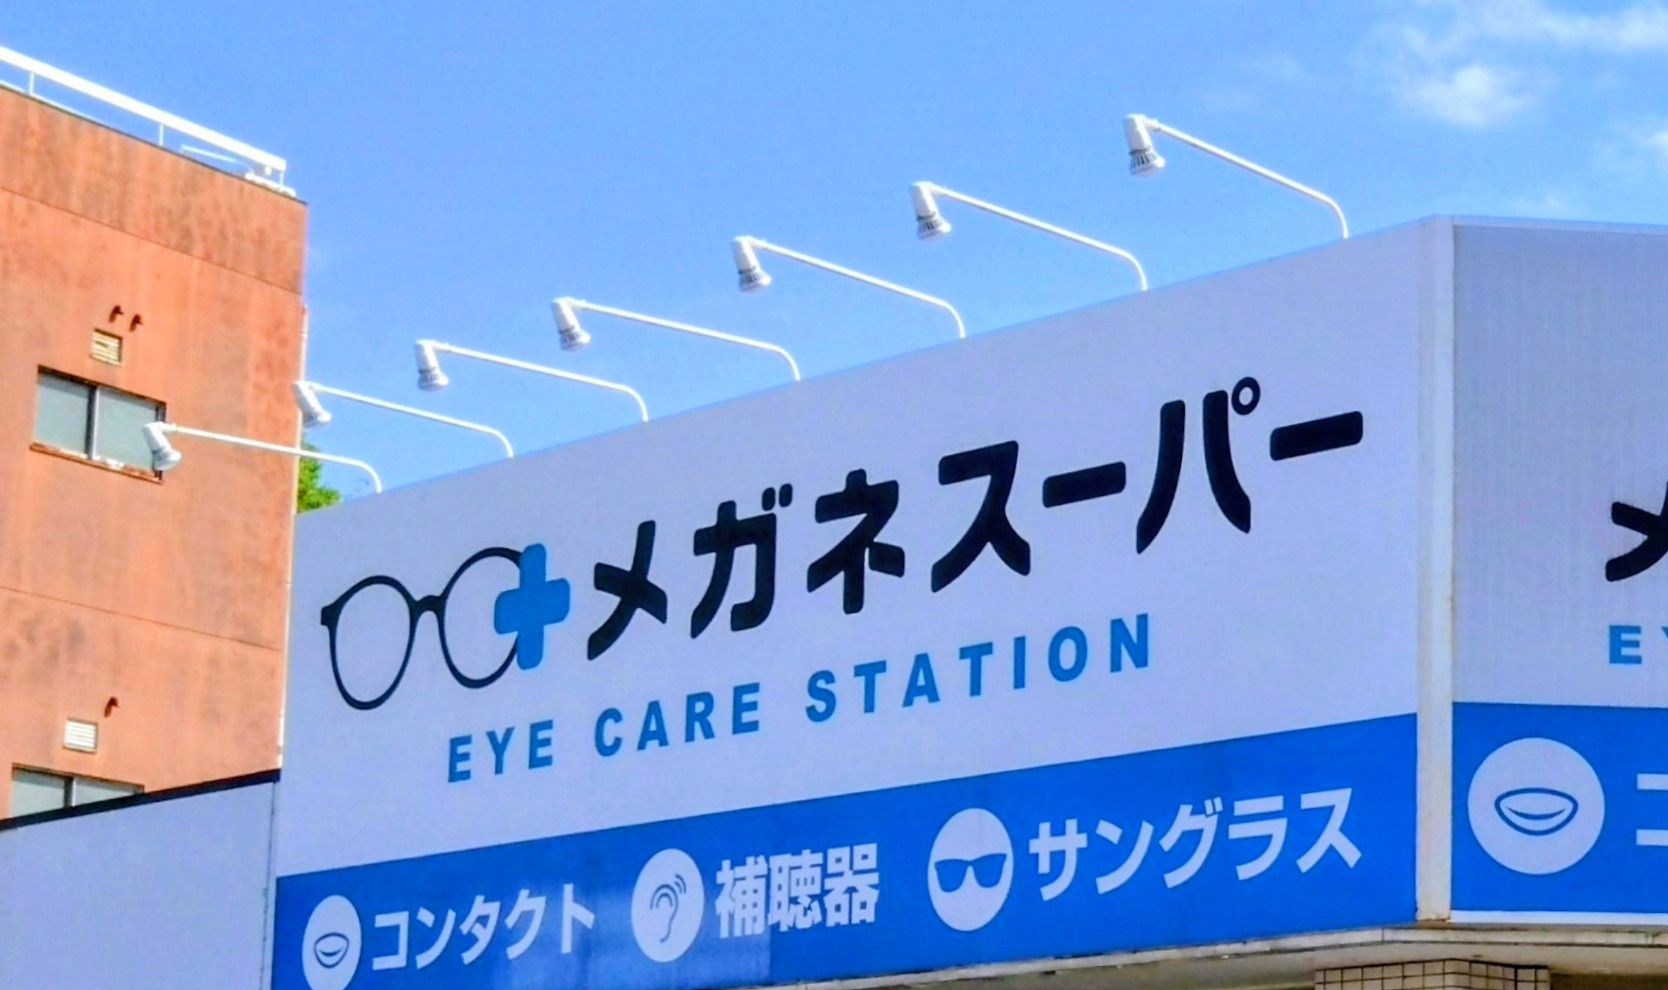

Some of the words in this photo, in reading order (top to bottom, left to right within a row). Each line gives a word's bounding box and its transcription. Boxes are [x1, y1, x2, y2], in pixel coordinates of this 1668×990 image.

[587, 377, 1363, 660] メガネスーパー
[447, 719, 555, 783] EYE
[594, 681, 761, 758] CARE
[804, 612, 1153, 722] STATION
[715, 842, 879, 940] 補聴器
[1028, 786, 1362, 902] サングラス
[371, 881, 596, 970] コンタクト
